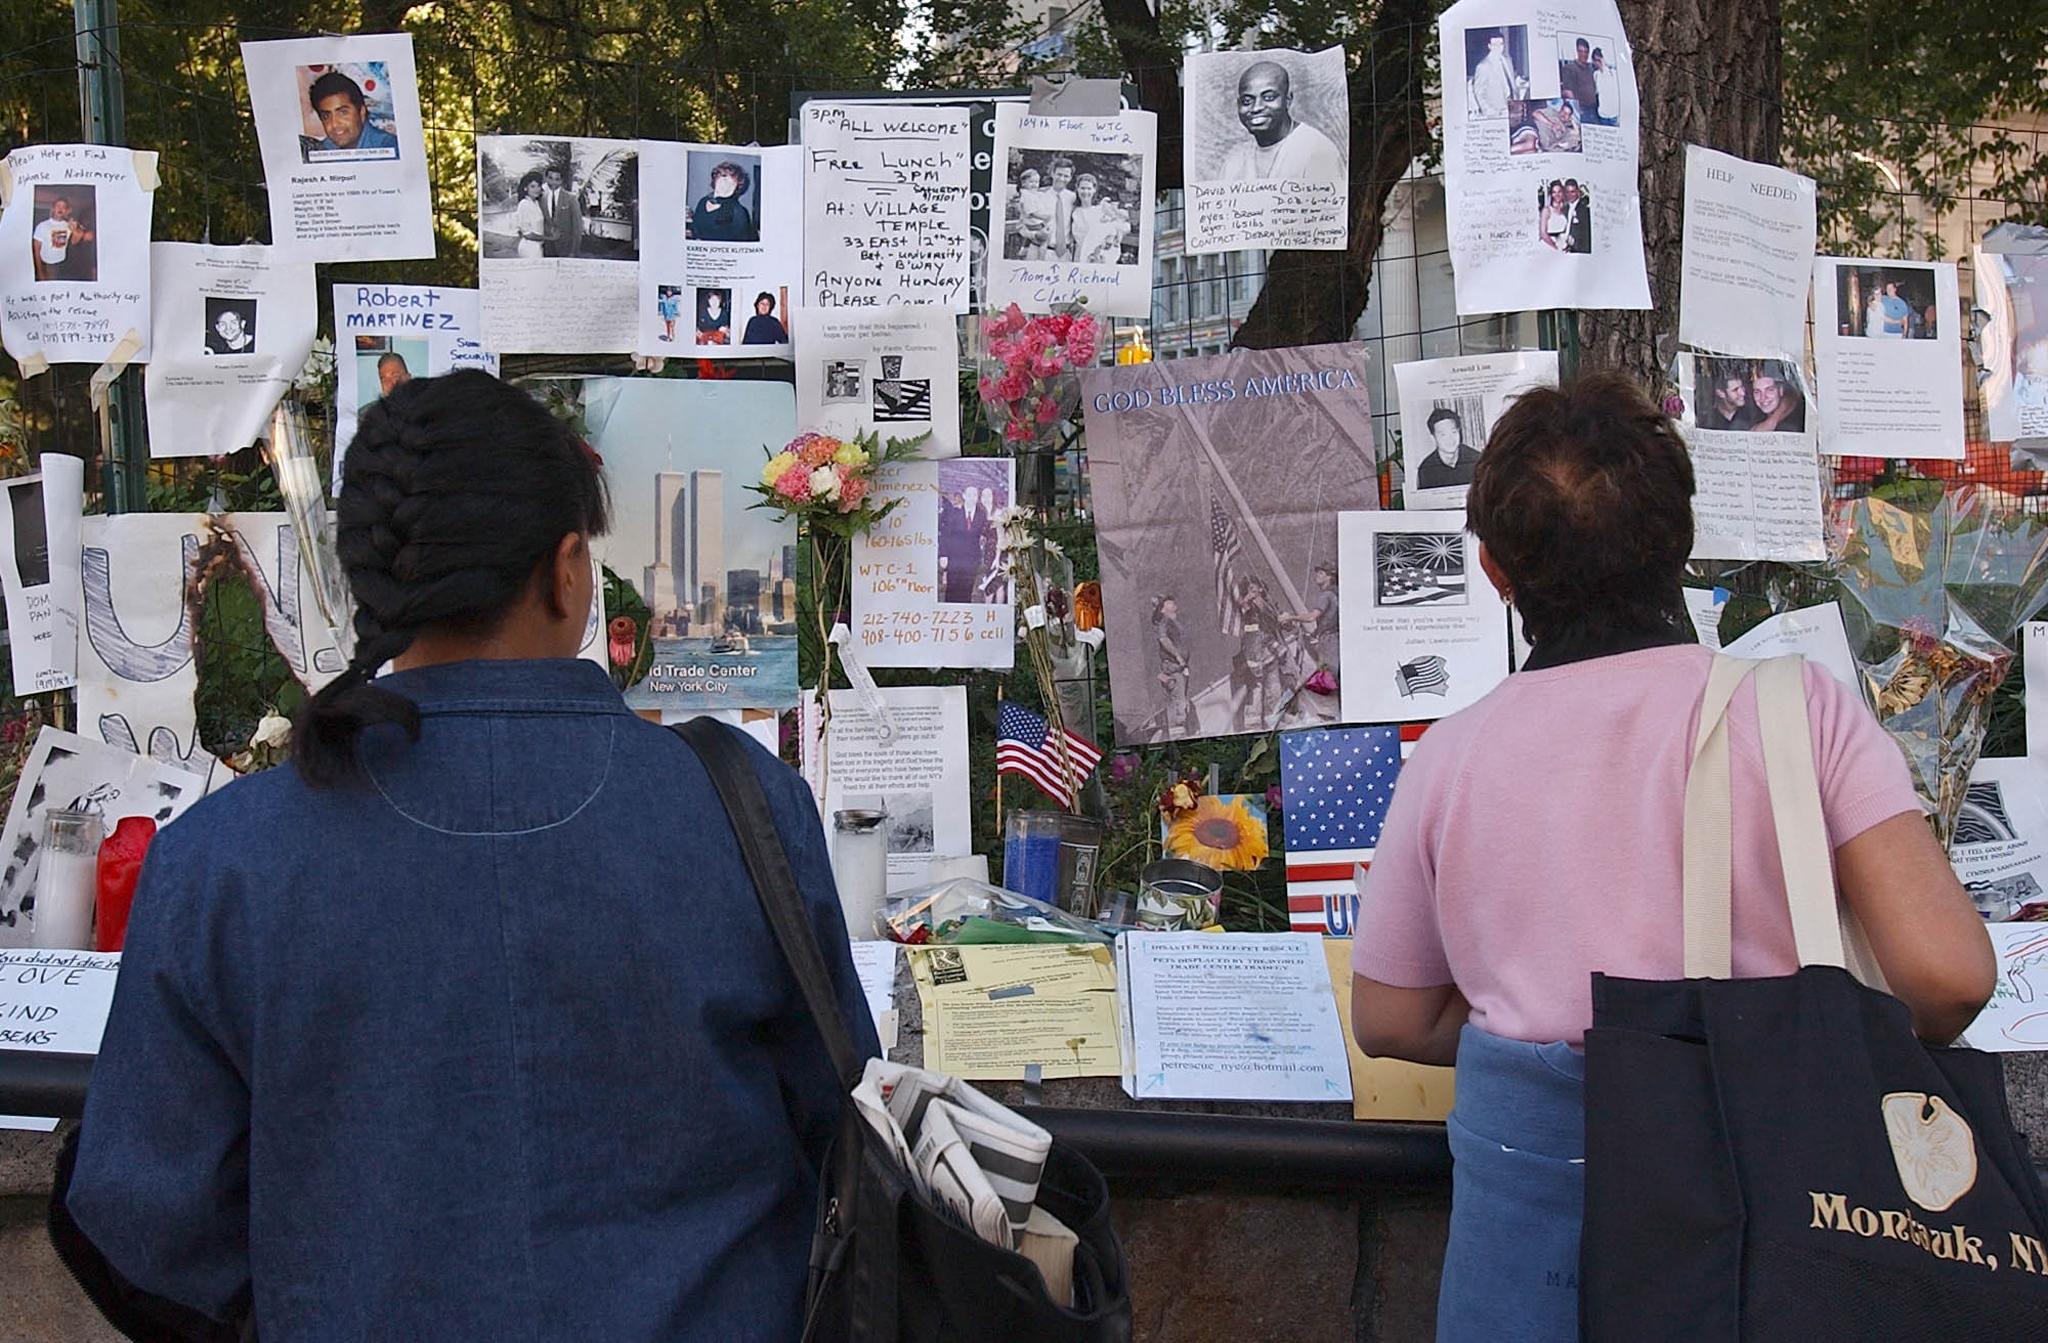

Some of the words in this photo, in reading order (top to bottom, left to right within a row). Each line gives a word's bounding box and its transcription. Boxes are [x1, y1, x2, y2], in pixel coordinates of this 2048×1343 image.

[291, 175, 318, 185] Rajesh
[1706, 167, 1735, 184] HELP
[1750, 183, 1798, 201] NEEDED
[843, 238, 864, 249] 33
[1009, 268, 1060, 284] Thomas
[1067, 267, 1120, 285] Richard
[346, 313, 460, 331] MARTINEZ
[1094, 389, 1153, 413] GOD
[1160, 379, 1237, 406] BLESS
[1243, 368, 1358, 397] AMERICA
[986, 610, 996, 622] H
[665, 664, 705, 677] Trade
[709, 664, 758, 678] Center
[650, 681, 674, 692] New
[678, 681, 703, 692] York
[705, 681, 729, 694] City
[1808, 1191, 1998, 1272] Montauk,
